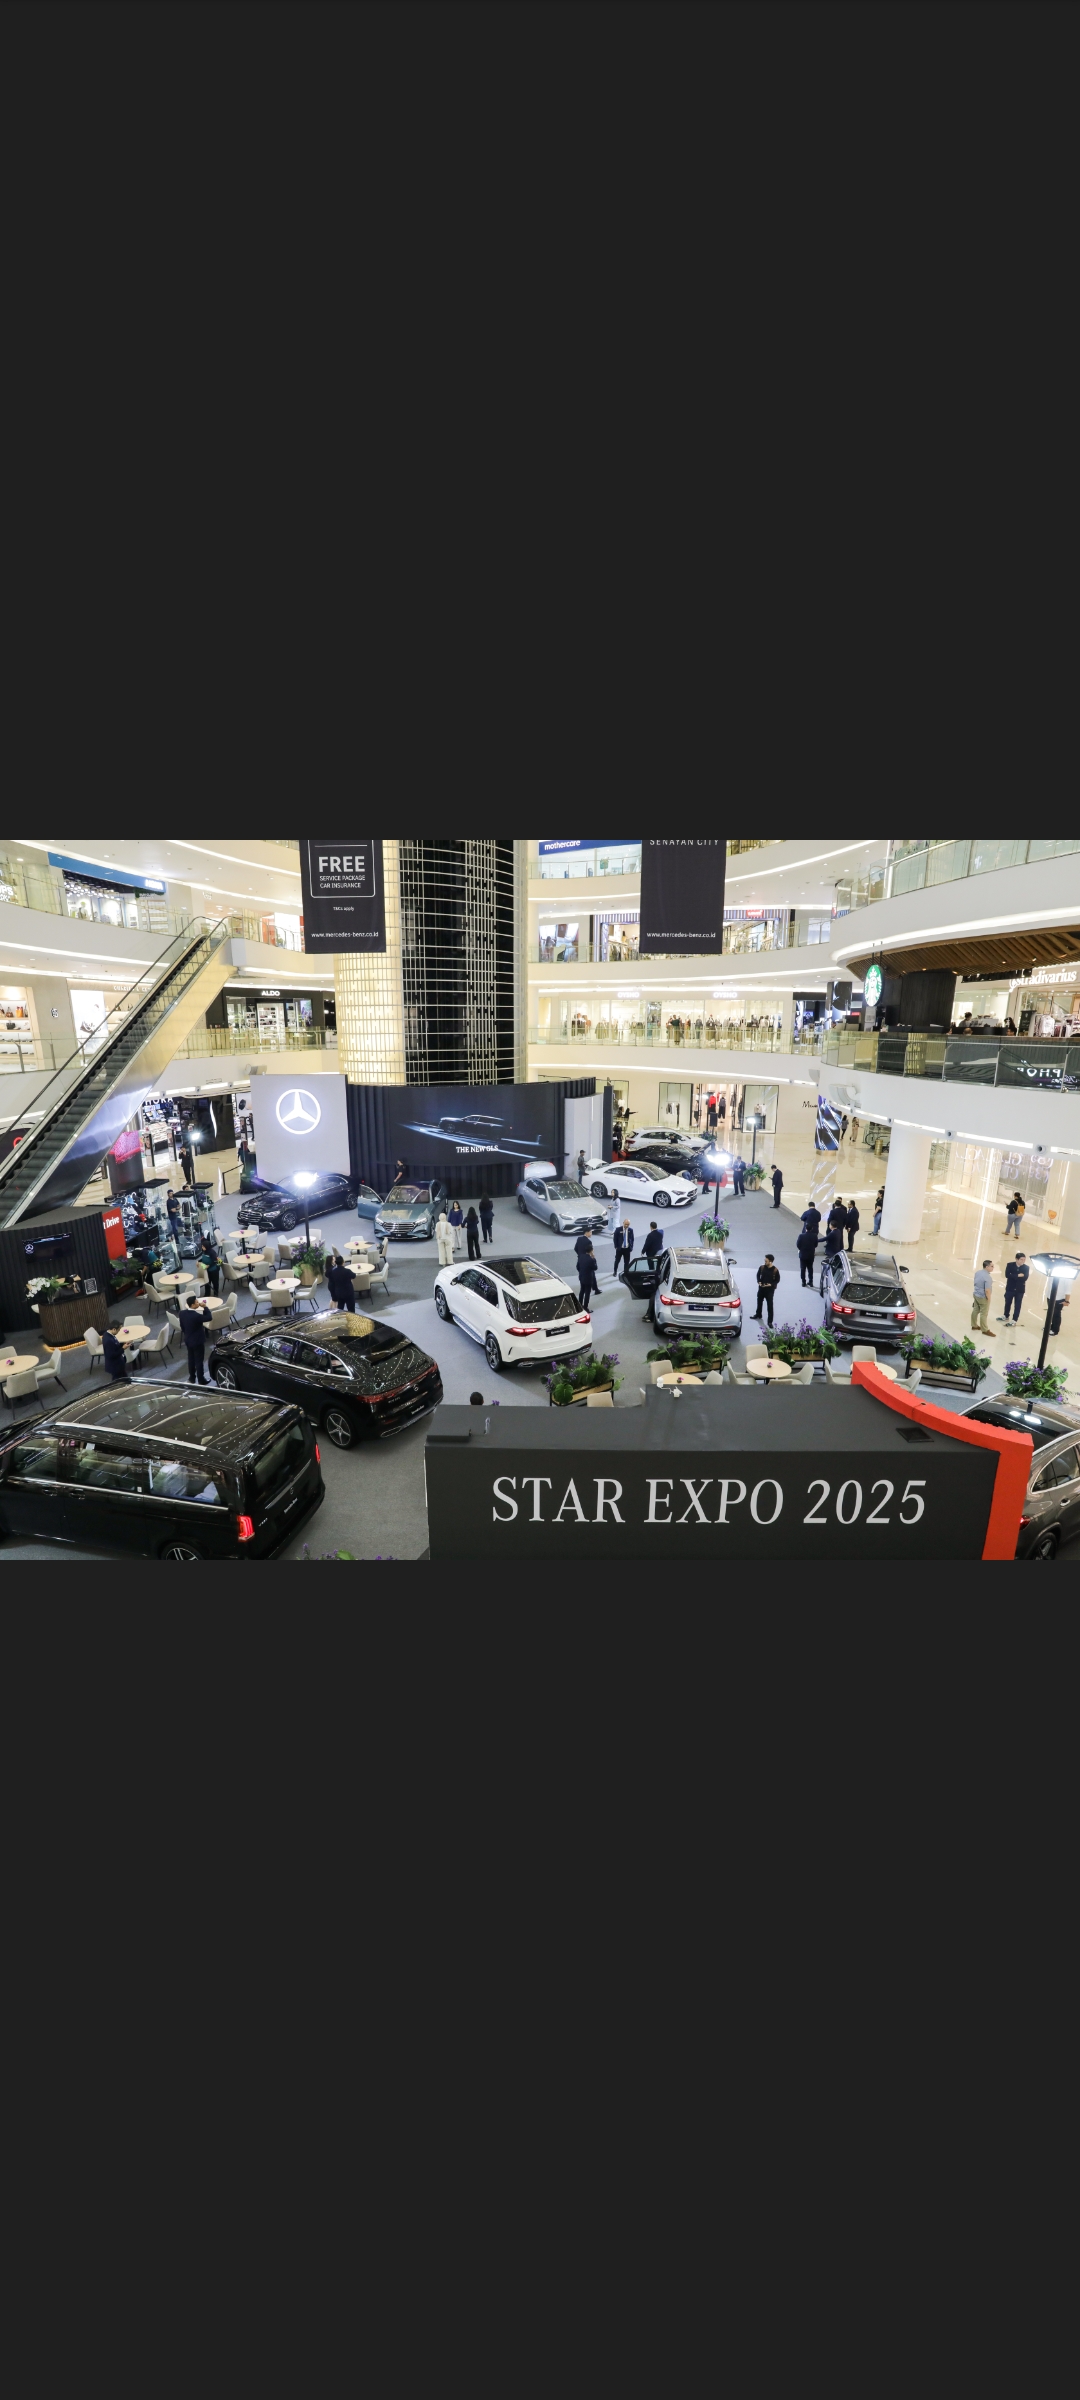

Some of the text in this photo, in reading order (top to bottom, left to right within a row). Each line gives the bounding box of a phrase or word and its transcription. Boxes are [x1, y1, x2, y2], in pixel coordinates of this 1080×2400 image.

[544, 840, 581, 850] mothercare
[318, 856, 366, 872] FREE
[713, 991, 738, 999] OYSHO
[470, 1145, 486, 1153] NEW
[492, 1476, 926, 1525] STAR EXPO 2025
